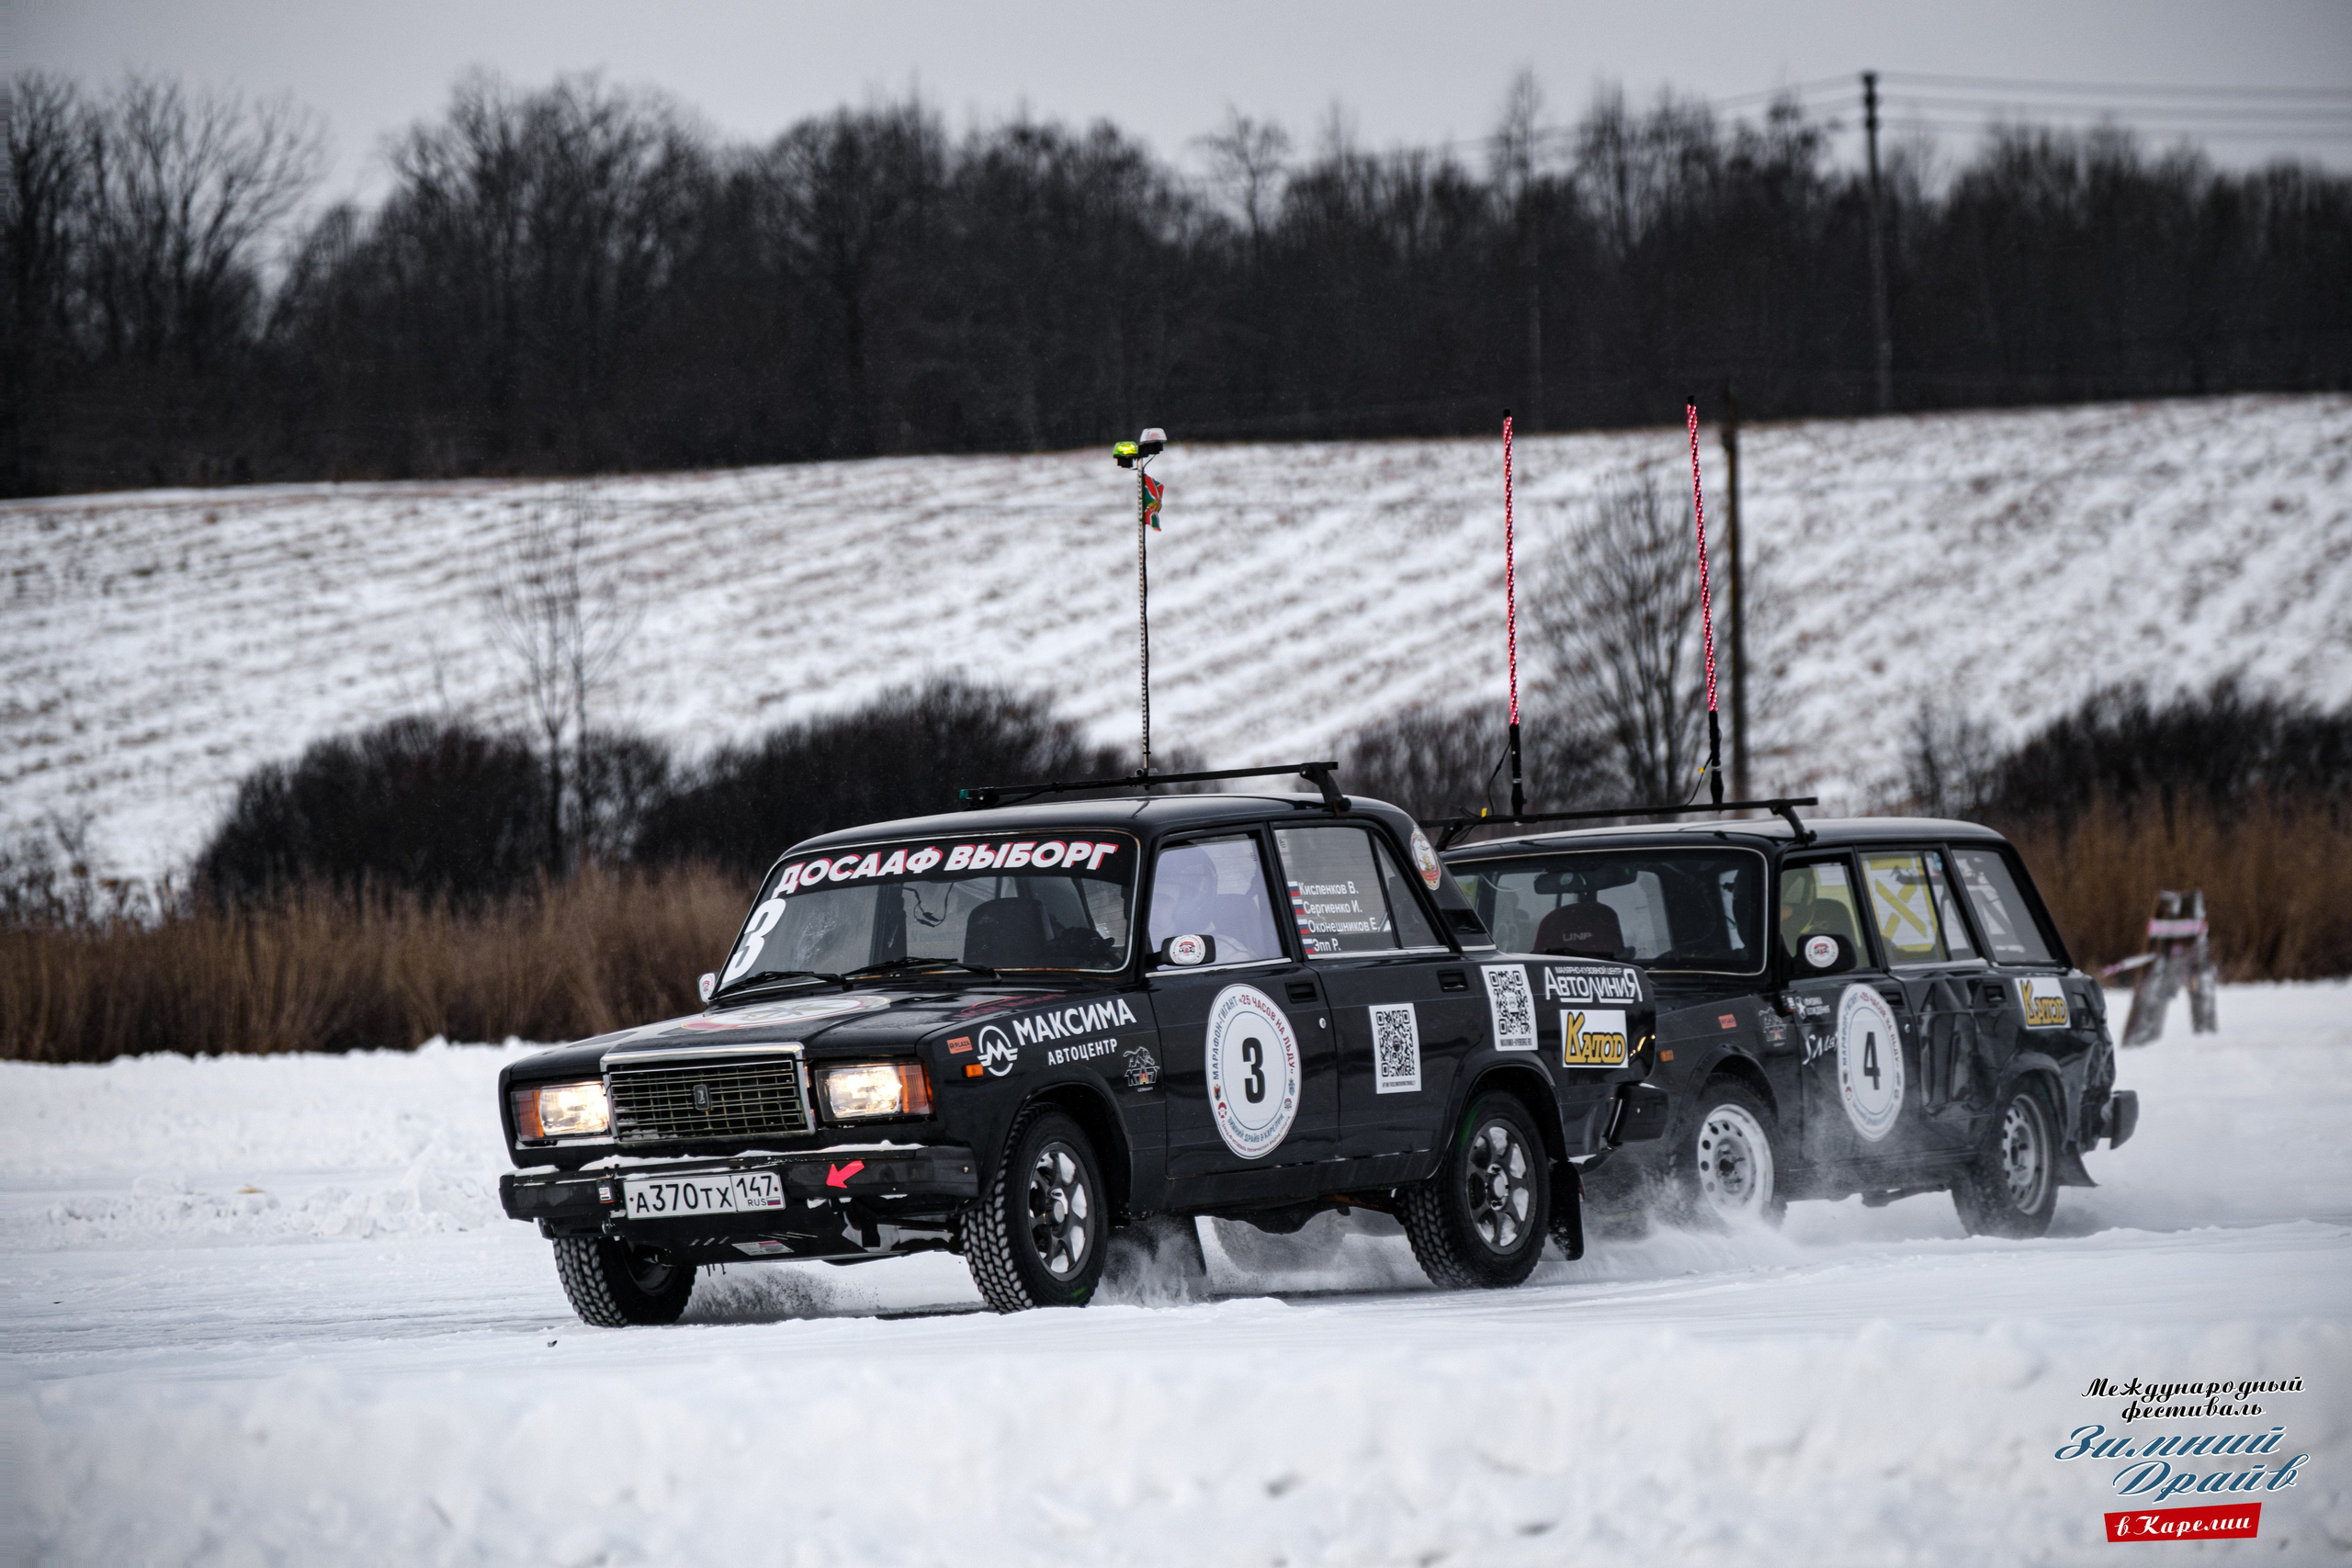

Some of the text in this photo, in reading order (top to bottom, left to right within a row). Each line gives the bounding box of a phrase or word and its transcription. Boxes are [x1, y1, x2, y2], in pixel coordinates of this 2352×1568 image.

[771, 840, 1119, 900] ДОСААФ ВЫБОРГ
[1298, 881, 1359, 897] Кисленков В.
[1303, 899, 1363, 917] Сергиенко И.
[1307, 919, 1369, 933] Оконешников
[718, 897, 786, 988] 3
[1312, 938, 1341, 953] Эпп Р.
[1012, 998, 1137, 1046] МАКСИМА
[1212, 996, 1238, 1080] МАРАФОН-ГИГАНТ
[1252, 997, 1276, 1021] ЧАСОВ
[1275, 1018, 1285, 1036] НА
[1047, 1038, 1118, 1066] АВТОЦЕНТР
[1242, 1037, 1266, 1104] 3
[1863, 1031, 1882, 1090] 4
[636, 1175, 772, 1213] А370ТХ 147
[747, 1198, 767, 1207] RUS
